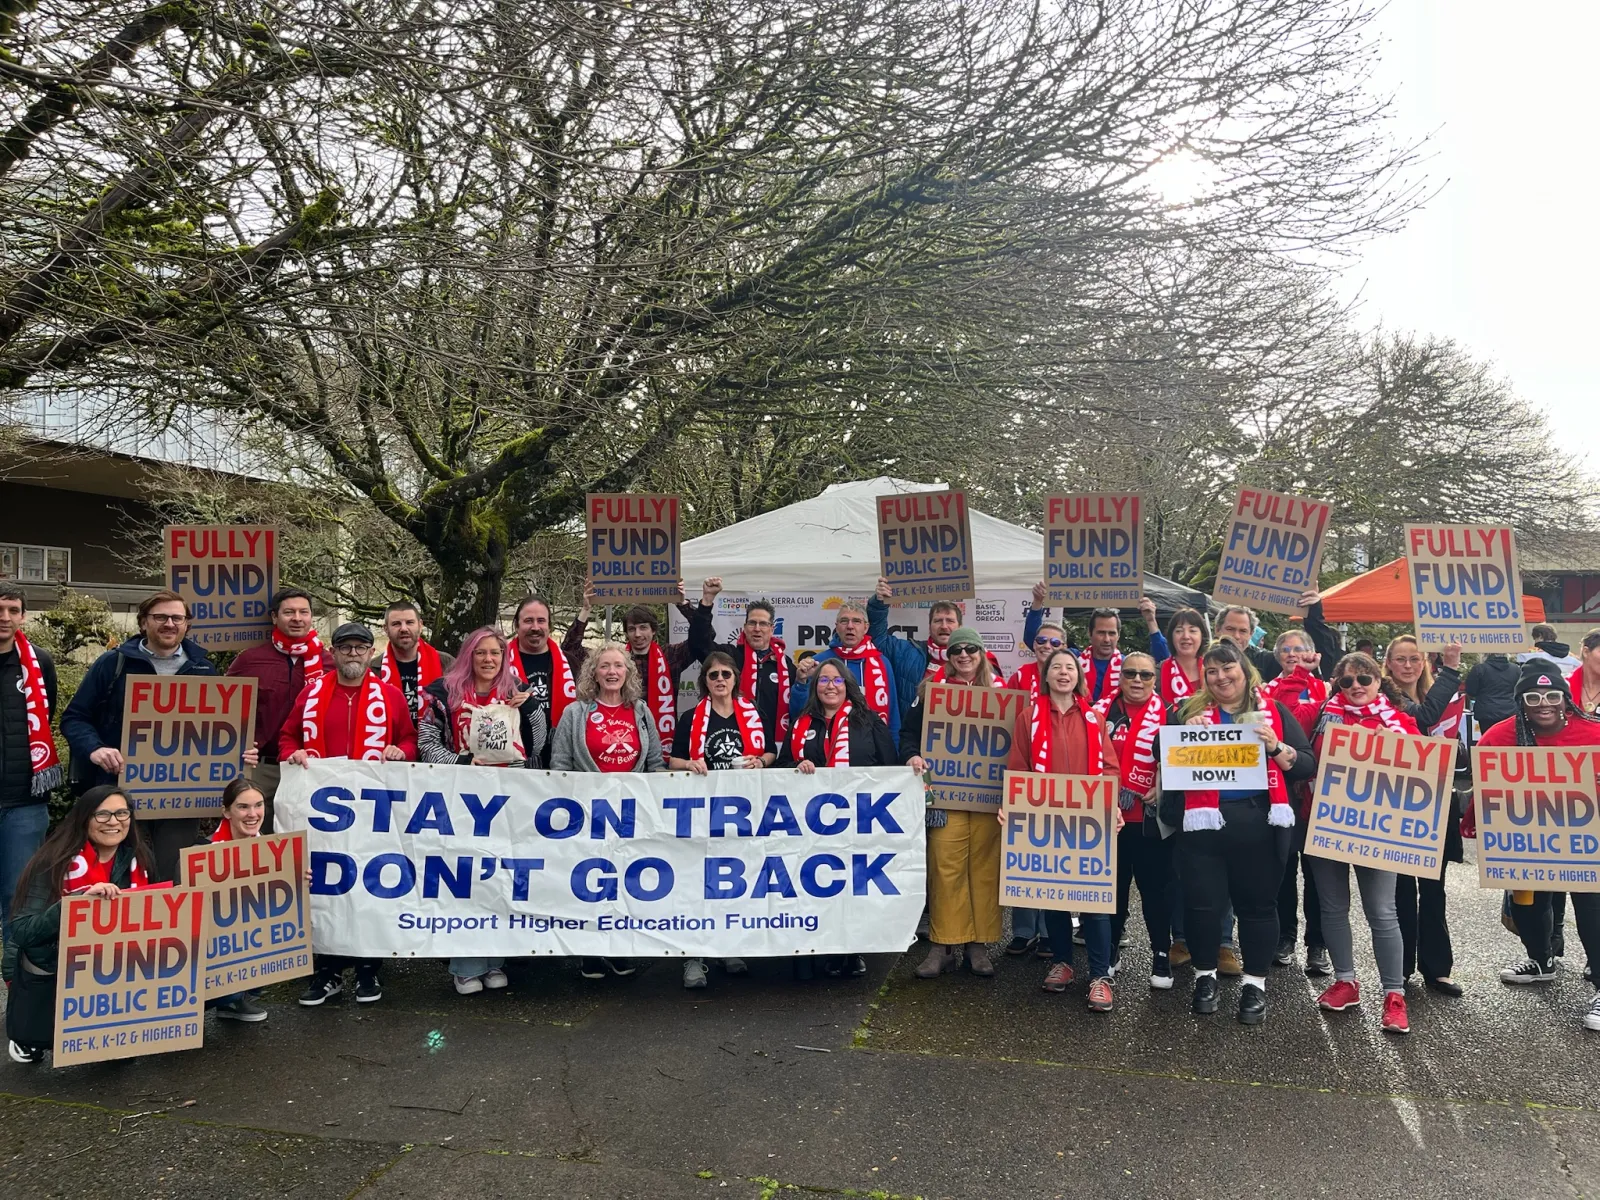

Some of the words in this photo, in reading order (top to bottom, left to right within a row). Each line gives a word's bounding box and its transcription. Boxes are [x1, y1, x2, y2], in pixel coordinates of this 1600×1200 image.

[592, 499, 665, 523] FULLY
[881, 495, 952, 524] FULLY
[1050, 497, 1128, 523] FULLY
[1238, 491, 1318, 528] FULLY
[172, 530, 261, 558] FULLY
[592, 528, 668, 556] FUND
[883, 524, 957, 556] FUND
[1049, 528, 1130, 557] FUND
[1229, 522, 1309, 562] FUND
[1411, 529, 1496, 557] FULLY
[593, 561, 645, 576] PUBLIC
[885, 558, 936, 576] PUBLIC
[1049, 563, 1103, 578] PUBLIC
[1224, 556, 1278, 580] PUBLIC
[1414, 563, 1505, 595] FUND
[172, 565, 265, 598] FUND
[618, 588, 633, 596] K-12
[642, 587, 667, 596] HIGHER
[892, 587, 910, 597] RE-K,
[912, 586, 926, 595] K-12
[928, 586, 933, 594] &
[936, 583, 960, 593] HIGHER
[962, 583, 970, 591] ED
[1075, 591, 1091, 599] K-12
[1094, 591, 1099, 599] &
[1101, 591, 1128, 599] HIGHER
[1131, 591, 1139, 599] ED
[191, 601, 236, 620] UBLIC
[771, 597, 795, 605] SIERRA
[1243, 589, 1260, 600] K-12
[1261, 592, 1266, 601] &
[1268, 593, 1294, 607] HIGHER
[1418, 601, 1479, 619] PUBLIC
[204, 632, 221, 643] K-12
[225, 632, 231, 642] &
[234, 630, 263, 642] HIGHER
[1471, 633, 1477, 643] &
[1479, 633, 1510, 643] HIGHER
[1513, 633, 1523, 643] ED
[132, 682, 237, 713] FULLY
[930, 688, 1012, 721] FULLY
[129, 721, 238, 756] FUND
[486, 740, 507, 750] WAIT
[927, 722, 1011, 758] FUND
[1180, 730, 1242, 741] PROTECT
[1328, 728, 1437, 771] FULLY
[126, 763, 201, 783] PUBLIC
[1192, 770, 1236, 781] NOW!
[1479, 752, 1588, 784] FULLY
[950, 791, 966, 802] K-12
[968, 792, 974, 802] &
[1009, 776, 1100, 809] FULLY
[1322, 763, 1432, 812] FUND
[160, 797, 181, 809] K-12
[185, 797, 192, 808] &
[195, 797, 223, 808] HIGHE
[308, 786, 511, 838] STAY
[534, 797, 636, 840] ON
[663, 792, 905, 838] TRACK
[1481, 789, 1595, 827] FUND
[1008, 812, 1102, 850] FUND
[1317, 802, 1392, 833] PUBLIC
[1348, 841, 1369, 856] K-12
[1372, 846, 1379, 858] &
[1383, 849, 1420, 865] HIGHER
[1424, 855, 1436, 868] ED
[1484, 832, 1560, 854] PUBLIC
[1570, 834, 1599, 855] ED
[188, 839, 287, 887] FULLY
[310, 851, 545, 902] DON'T
[570, 857, 674, 902] GO
[704, 853, 901, 900] BACK
[1006, 852, 1070, 874] PUBLIC
[1523, 869, 1544, 880] K-12
[1548, 869, 1556, 881] &
[1559, 870, 1597, 882] HIGHER
[212, 880, 293, 928] UND
[1037, 888, 1055, 899] K-12
[1058, 889, 1064, 900] &
[1068, 890, 1099, 902] HIGHER
[1102, 892, 1112, 903] ED
[69, 893, 186, 937] FULLY
[398, 913, 498, 934] Support
[509, 914, 588, 933] Higher
[598, 914, 716, 931] Education
[726, 912, 819, 932] Funding
[206, 928, 262, 960] UBLIC
[66, 938, 188, 989] FUND
[228, 968, 247, 983] K-12
[251, 965, 258, 977] &
[261, 957, 294, 975] HIGHER
[297, 954, 308, 967] ED
[64, 990, 147, 1020] PUBLIC
[103, 1033, 126, 1048] K-12
[130, 1031, 138, 1044] &
[143, 1026, 181, 1042] HIGHER
[185, 1023, 197, 1037] ED
